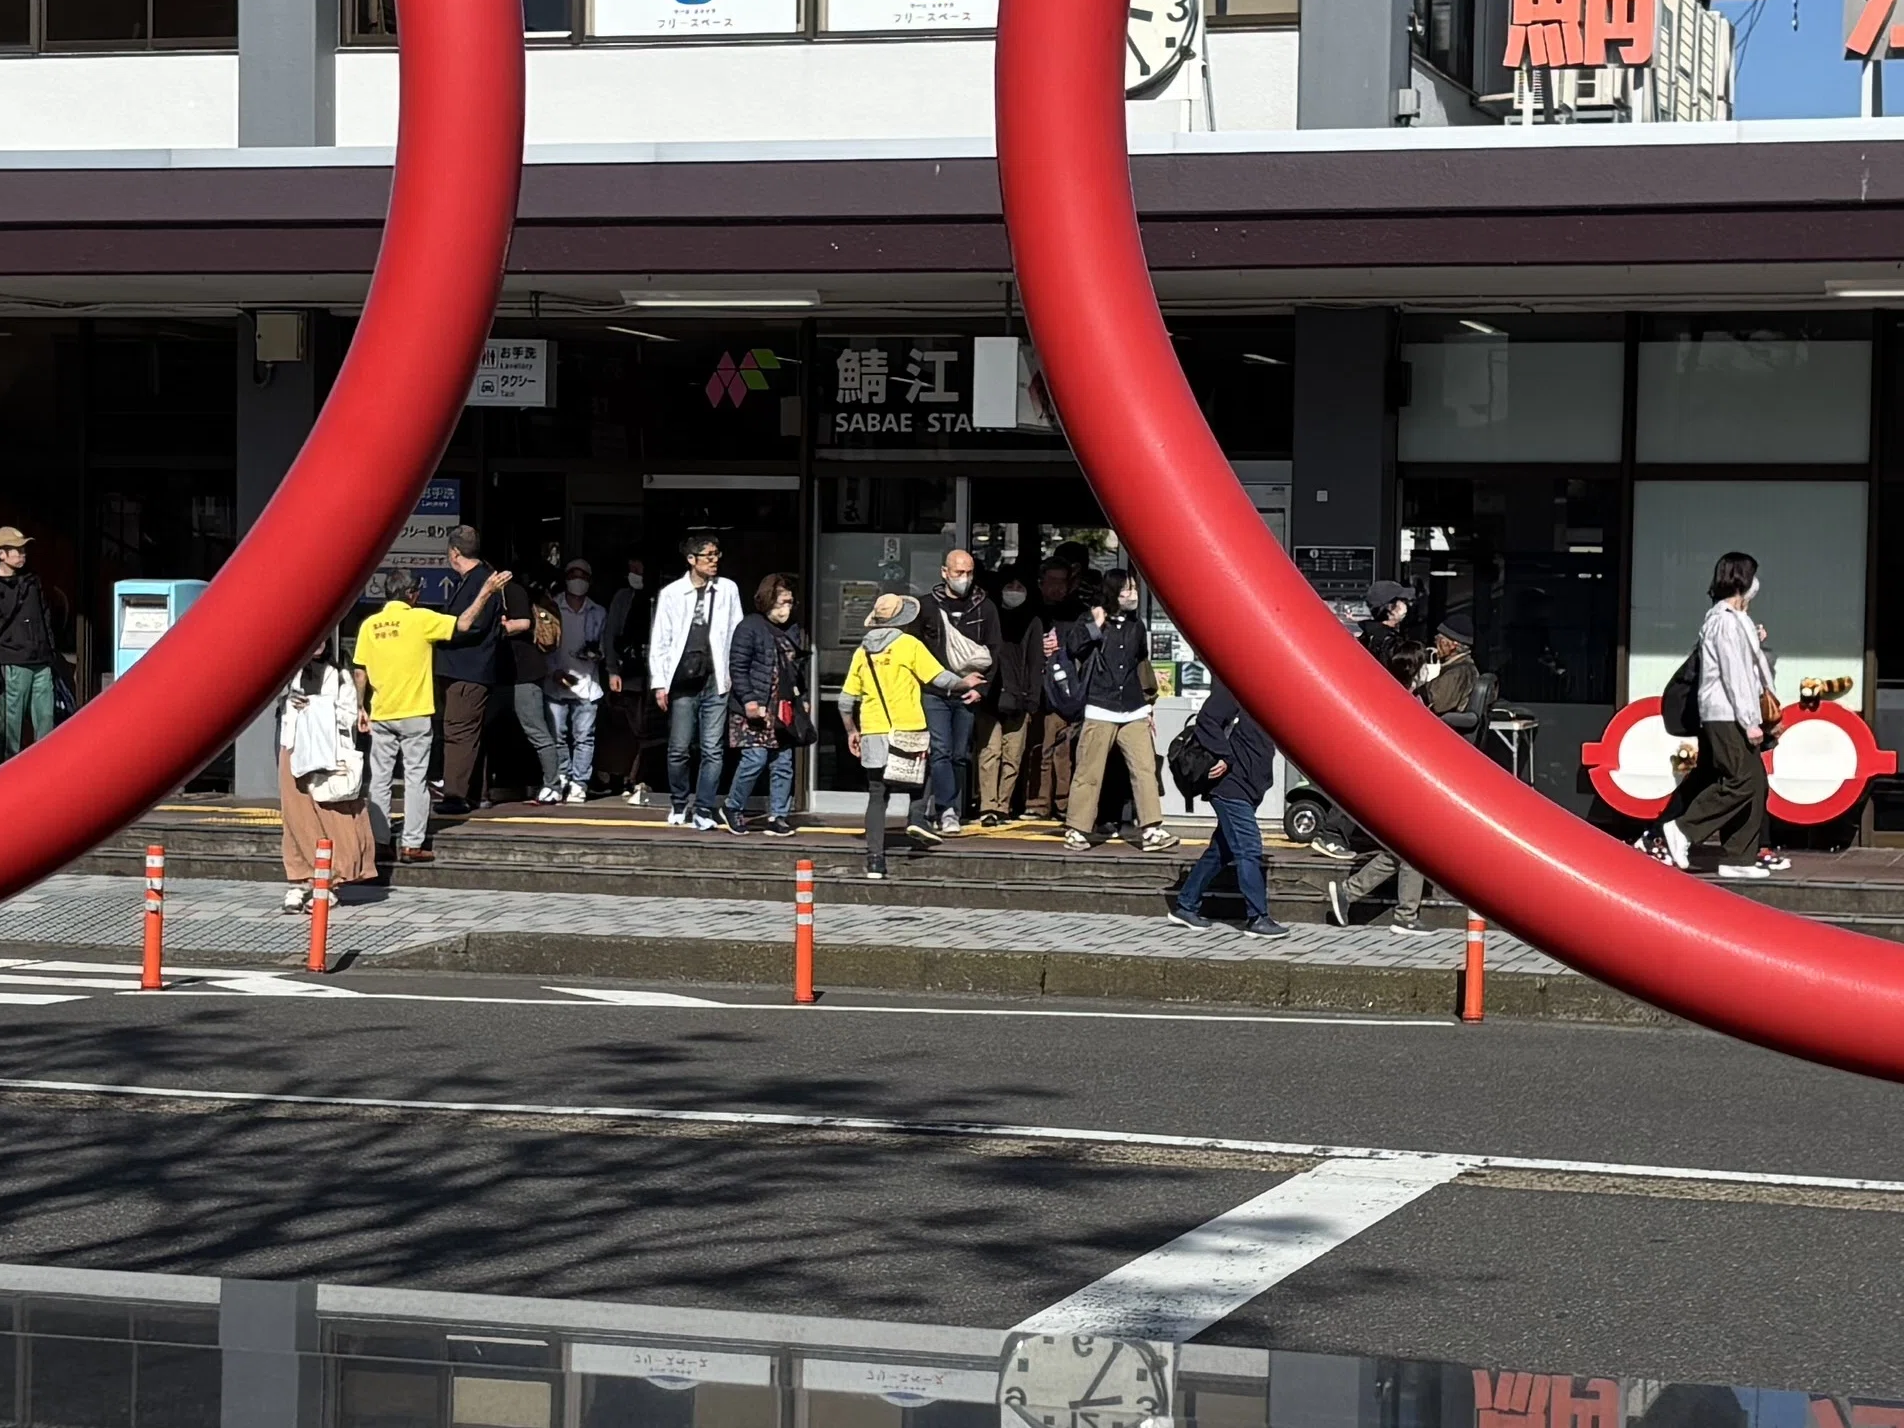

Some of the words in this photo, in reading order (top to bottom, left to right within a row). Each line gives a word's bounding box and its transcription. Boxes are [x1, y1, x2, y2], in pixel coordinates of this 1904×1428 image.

[657, 18, 733, 29] フリースペース
[894, 12, 971, 24] フリースペース
[500, 375, 536, 387] タクシー
[836, 348, 959, 404] 鯖江
[836, 413, 913, 432] SABAE
